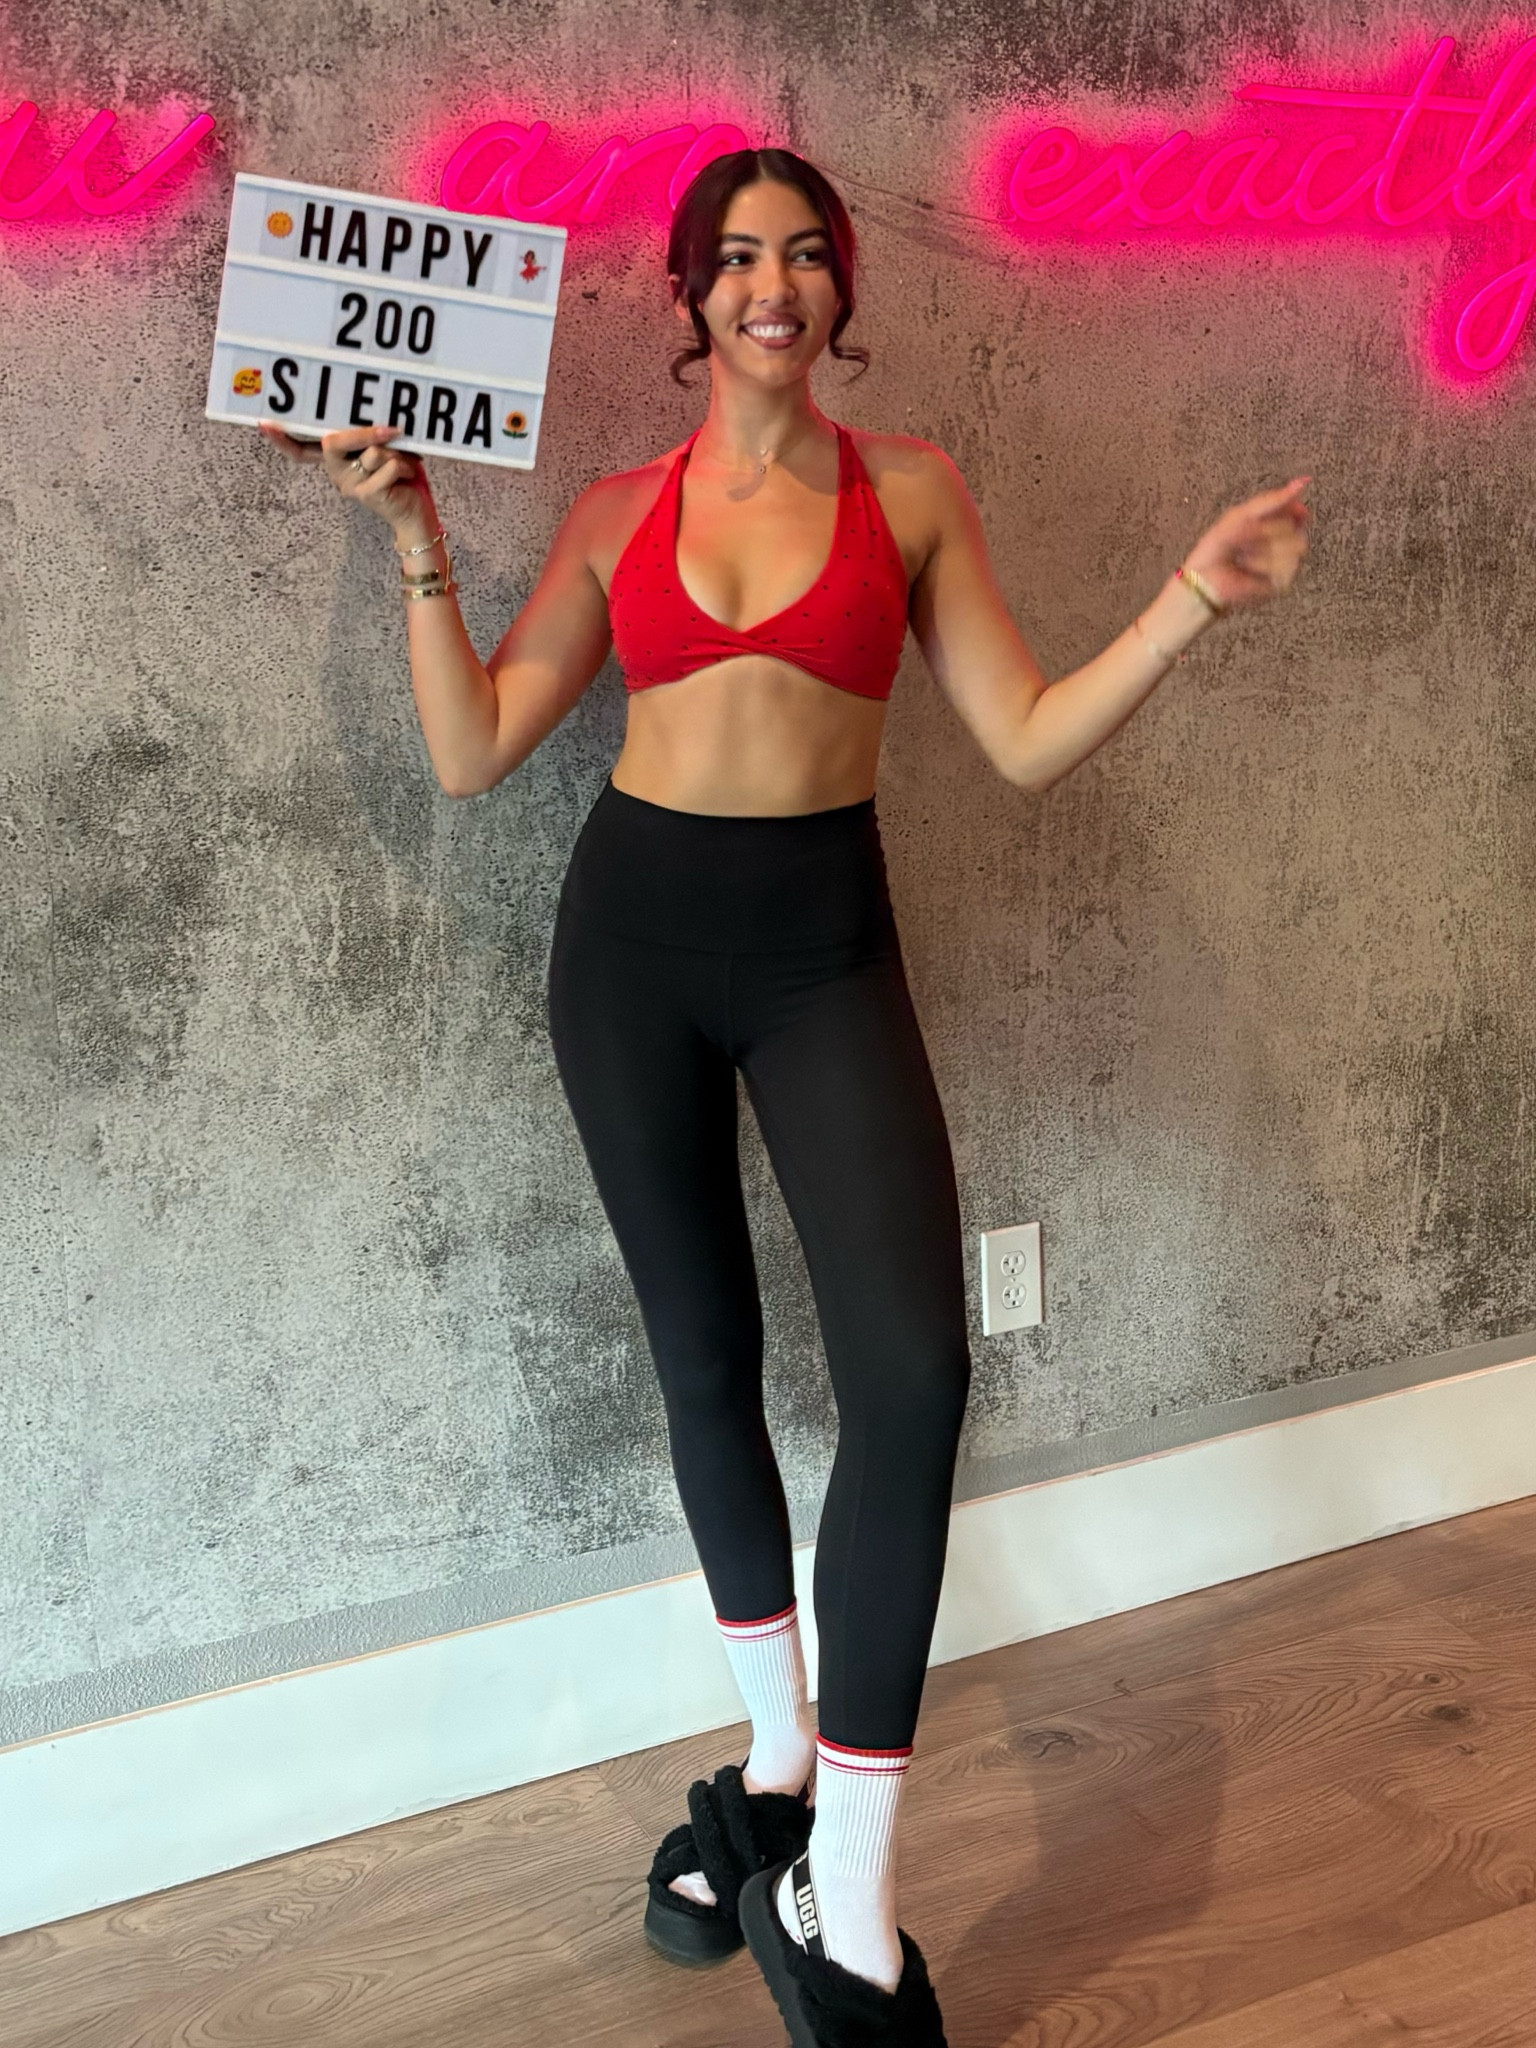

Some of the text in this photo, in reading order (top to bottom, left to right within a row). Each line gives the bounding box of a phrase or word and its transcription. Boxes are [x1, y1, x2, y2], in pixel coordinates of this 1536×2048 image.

[299, 202, 493, 287] HAPPY
[336, 292, 436, 355] 200
[268, 357, 492, 449] SIERRA
[796, 1882, 819, 1940] UGG
